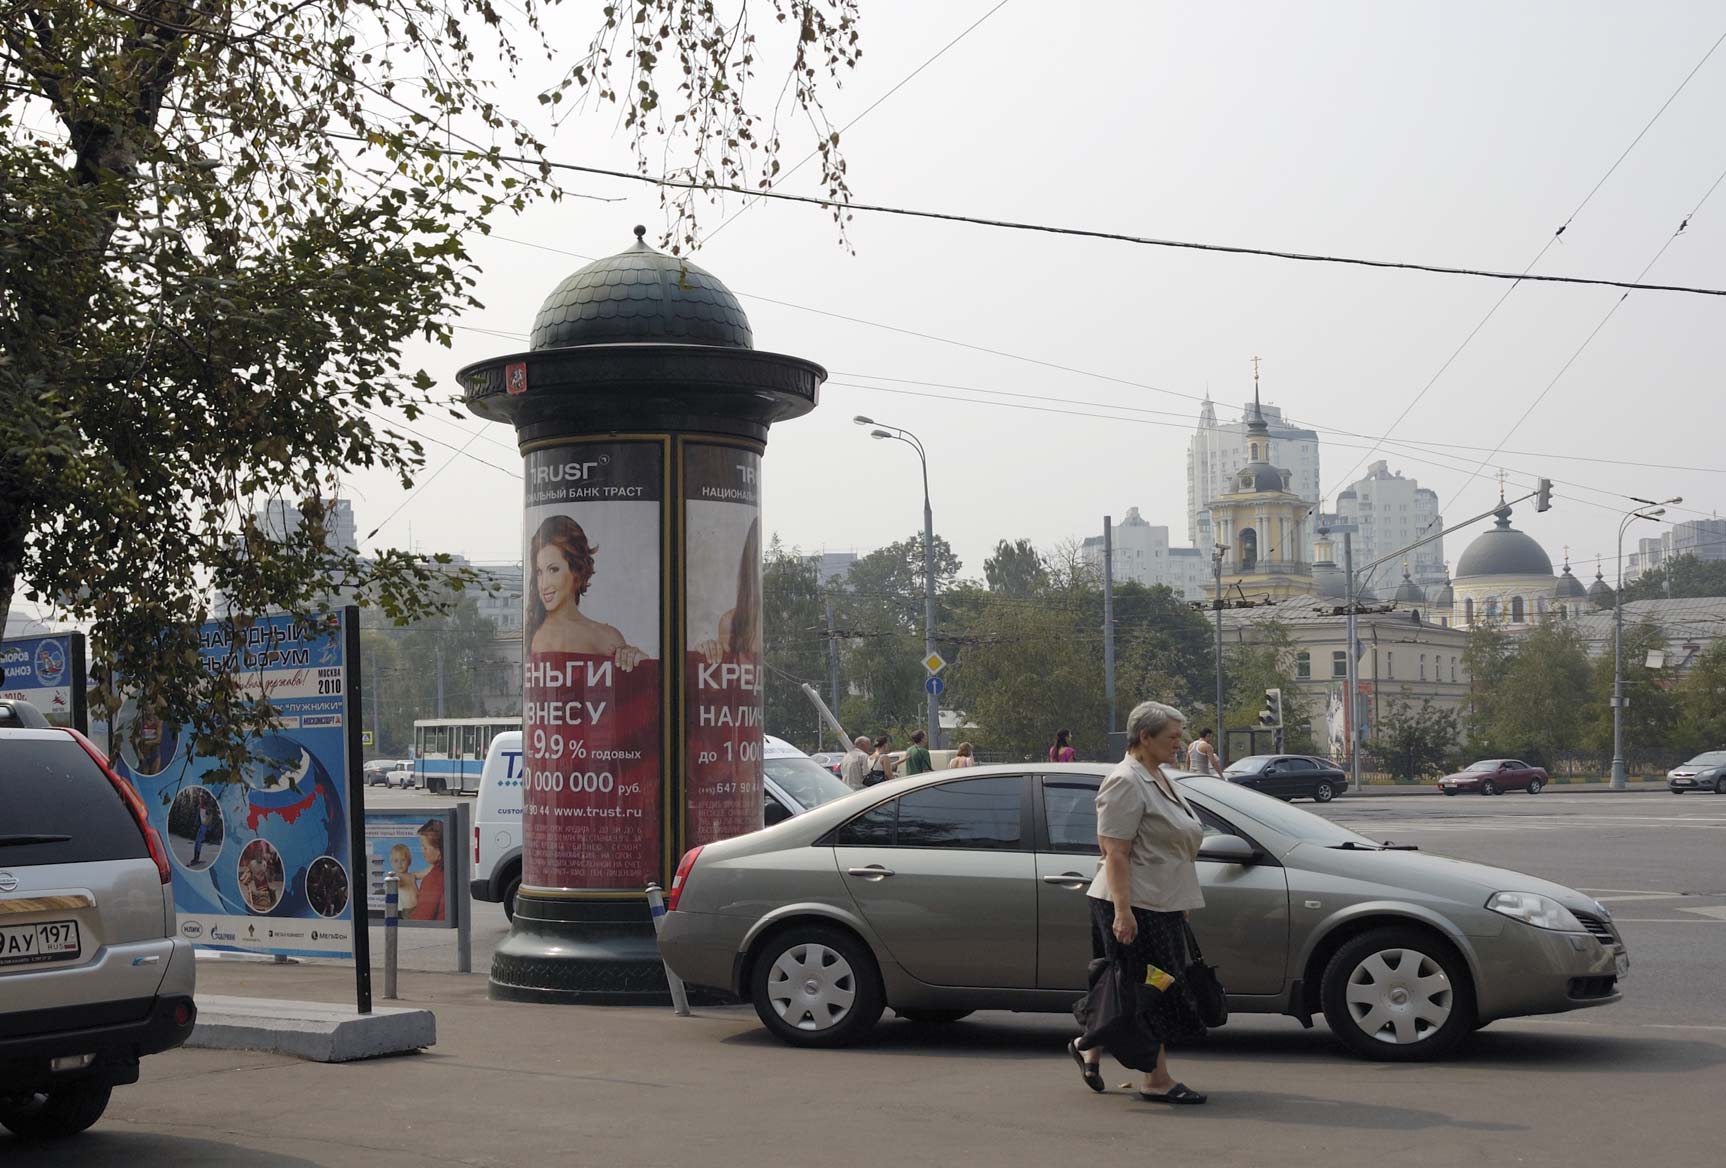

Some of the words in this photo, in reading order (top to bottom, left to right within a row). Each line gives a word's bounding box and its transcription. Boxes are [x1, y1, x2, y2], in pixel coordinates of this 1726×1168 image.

[569, 487, 599, 498] БАНК
[603, 486, 643, 497] ТРАСТ
[318, 668, 341, 678] МОСКВА
[318, 679, 341, 695] 2010
[534, 729, 564, 760] 9.9
[569, 740, 587, 759] %
[591, 750, 642, 761] годовых
[698, 752, 718, 765] до
[723, 741, 733, 762] 1
[534, 771, 564, 792] 000
[569, 772, 614, 793] 000
[618, 782, 641, 796] руб.
[716, 782, 737, 793] 647
[740, 782, 751, 793] 90
[539, 805, 550, 816] 44
[554, 805, 642, 817] www.trust.ru
[39, 924, 71, 944] 197
[47, 943, 64, 951] RUS
